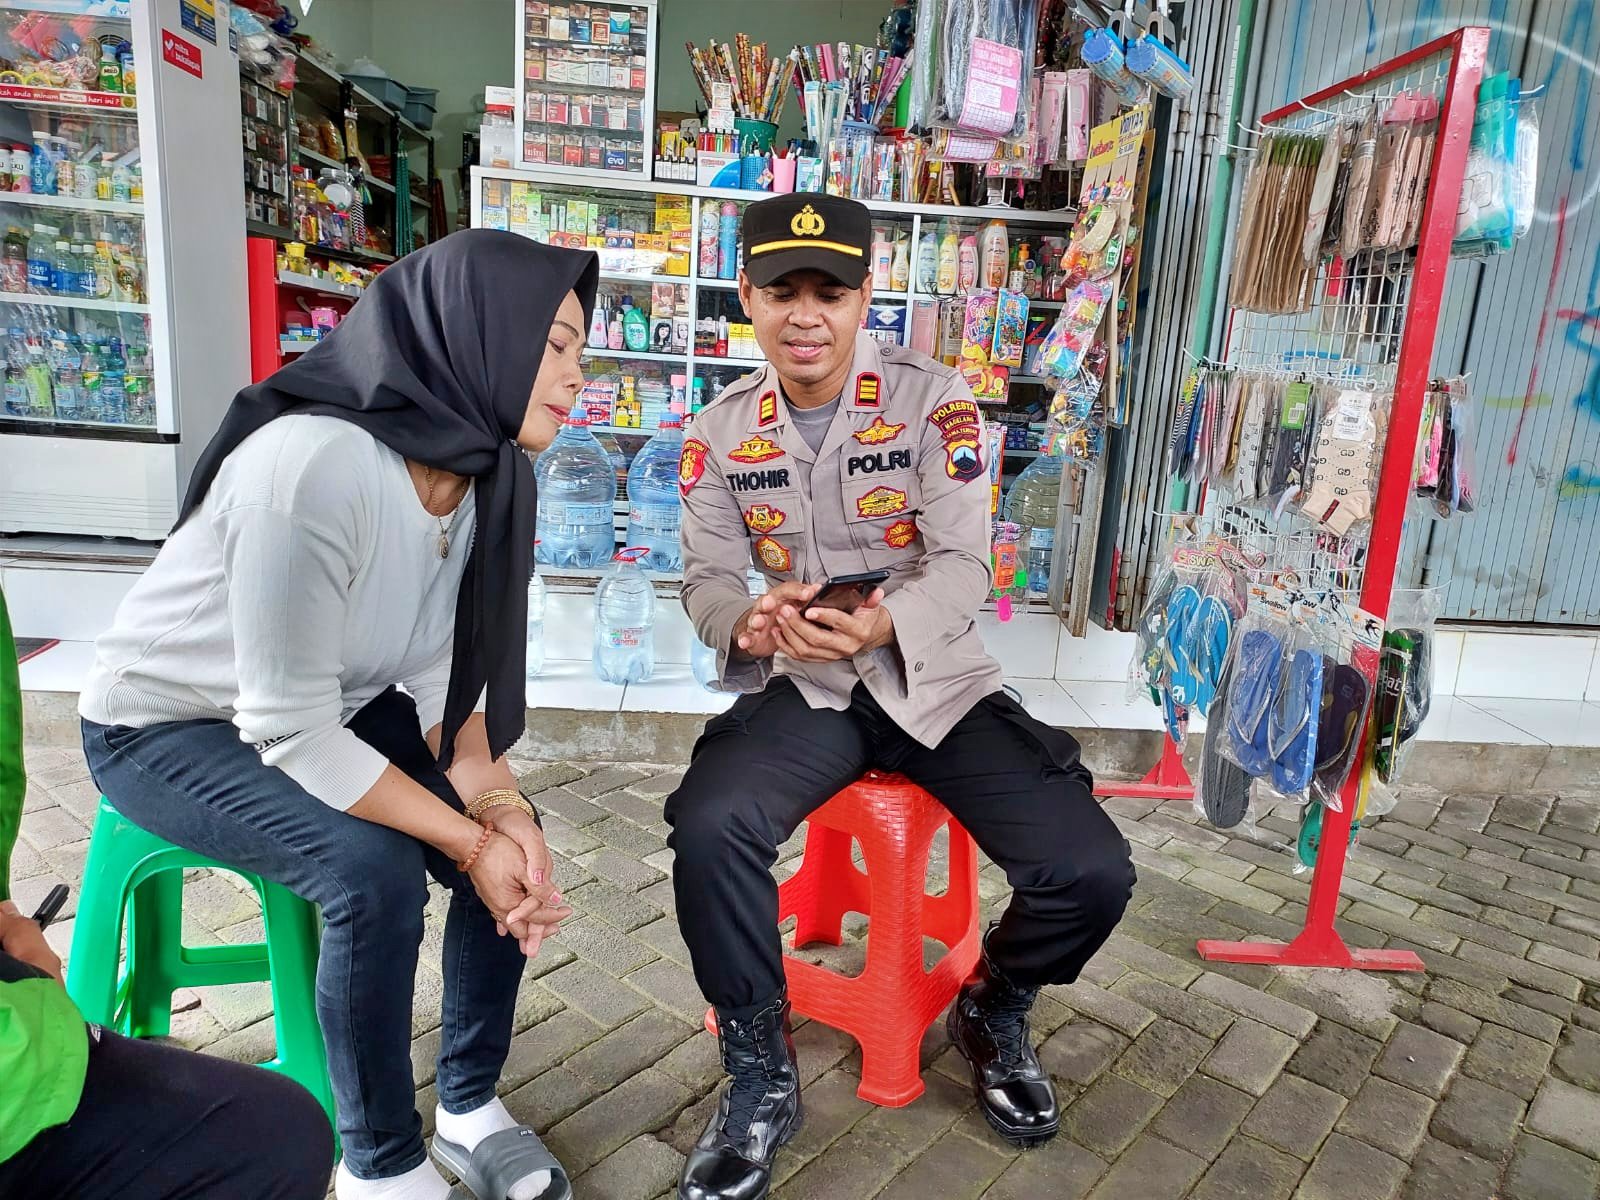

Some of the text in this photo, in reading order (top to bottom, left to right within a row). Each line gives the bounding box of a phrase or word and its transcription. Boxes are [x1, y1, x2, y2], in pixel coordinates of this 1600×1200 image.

[933, 402, 975, 421] POLRESTA
[944, 416, 974, 430] MAGELANG
[848, 449, 911, 476] POLRI
[726, 468, 790, 492] THOHIR
[1260, 596, 1288, 611] Swallow
